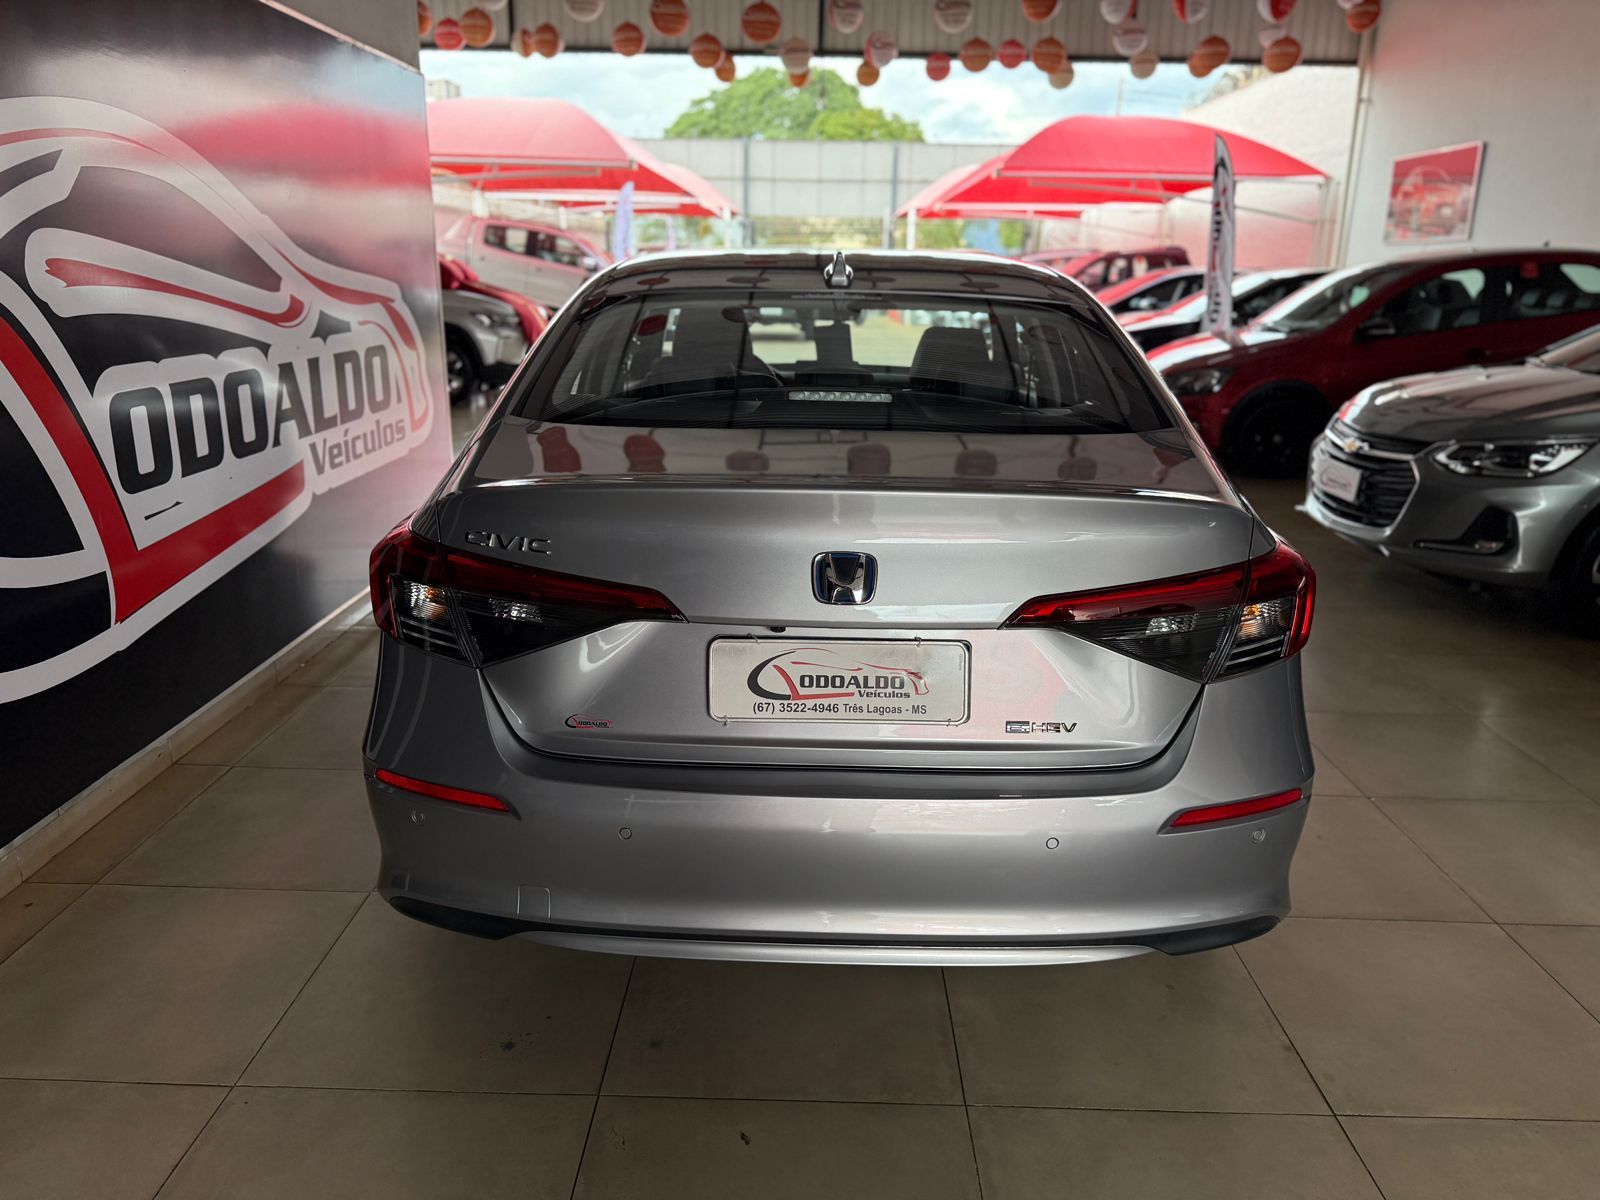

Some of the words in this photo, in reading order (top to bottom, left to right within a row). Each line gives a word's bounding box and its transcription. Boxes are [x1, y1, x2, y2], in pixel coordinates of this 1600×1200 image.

[309, 418, 407, 476] Veículos
[465, 530, 552, 555] CIVIC
[858, 689, 911, 699] Veículos
[752, 702, 775, 715] (67)
[779, 702, 840, 713] 3522-4946
[843, 703, 864, 714] Três
[866, 704, 903, 716] Lagoas
[911, 704, 927, 715] MS
